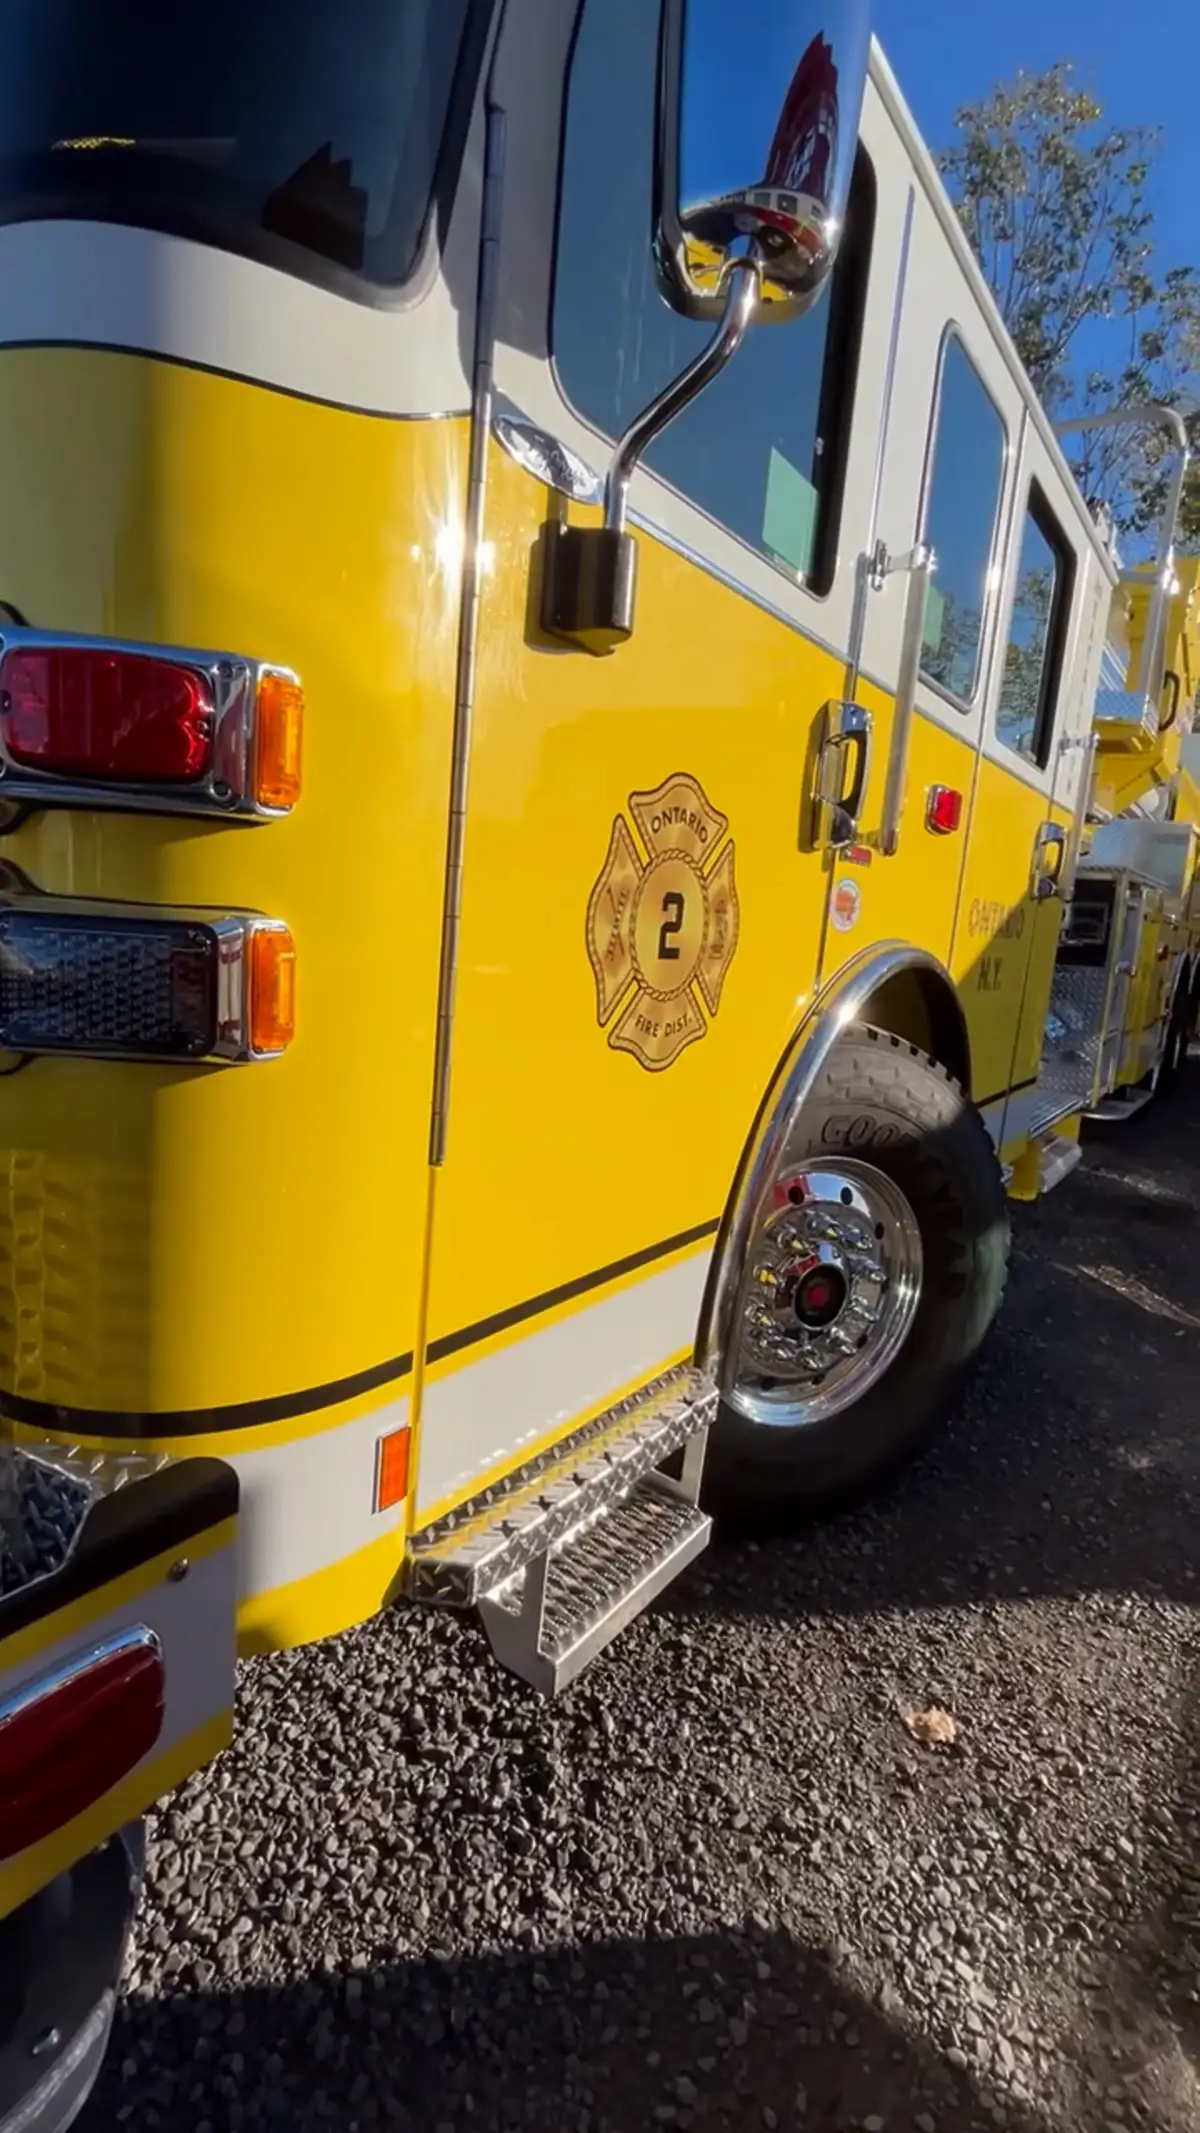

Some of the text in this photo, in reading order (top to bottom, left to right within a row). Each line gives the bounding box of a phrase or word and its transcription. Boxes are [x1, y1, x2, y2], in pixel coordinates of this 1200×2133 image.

[651, 806, 708, 844] ONTARIO
[658, 891, 685, 960] 2
[635, 1013, 659, 1038] FIRE
